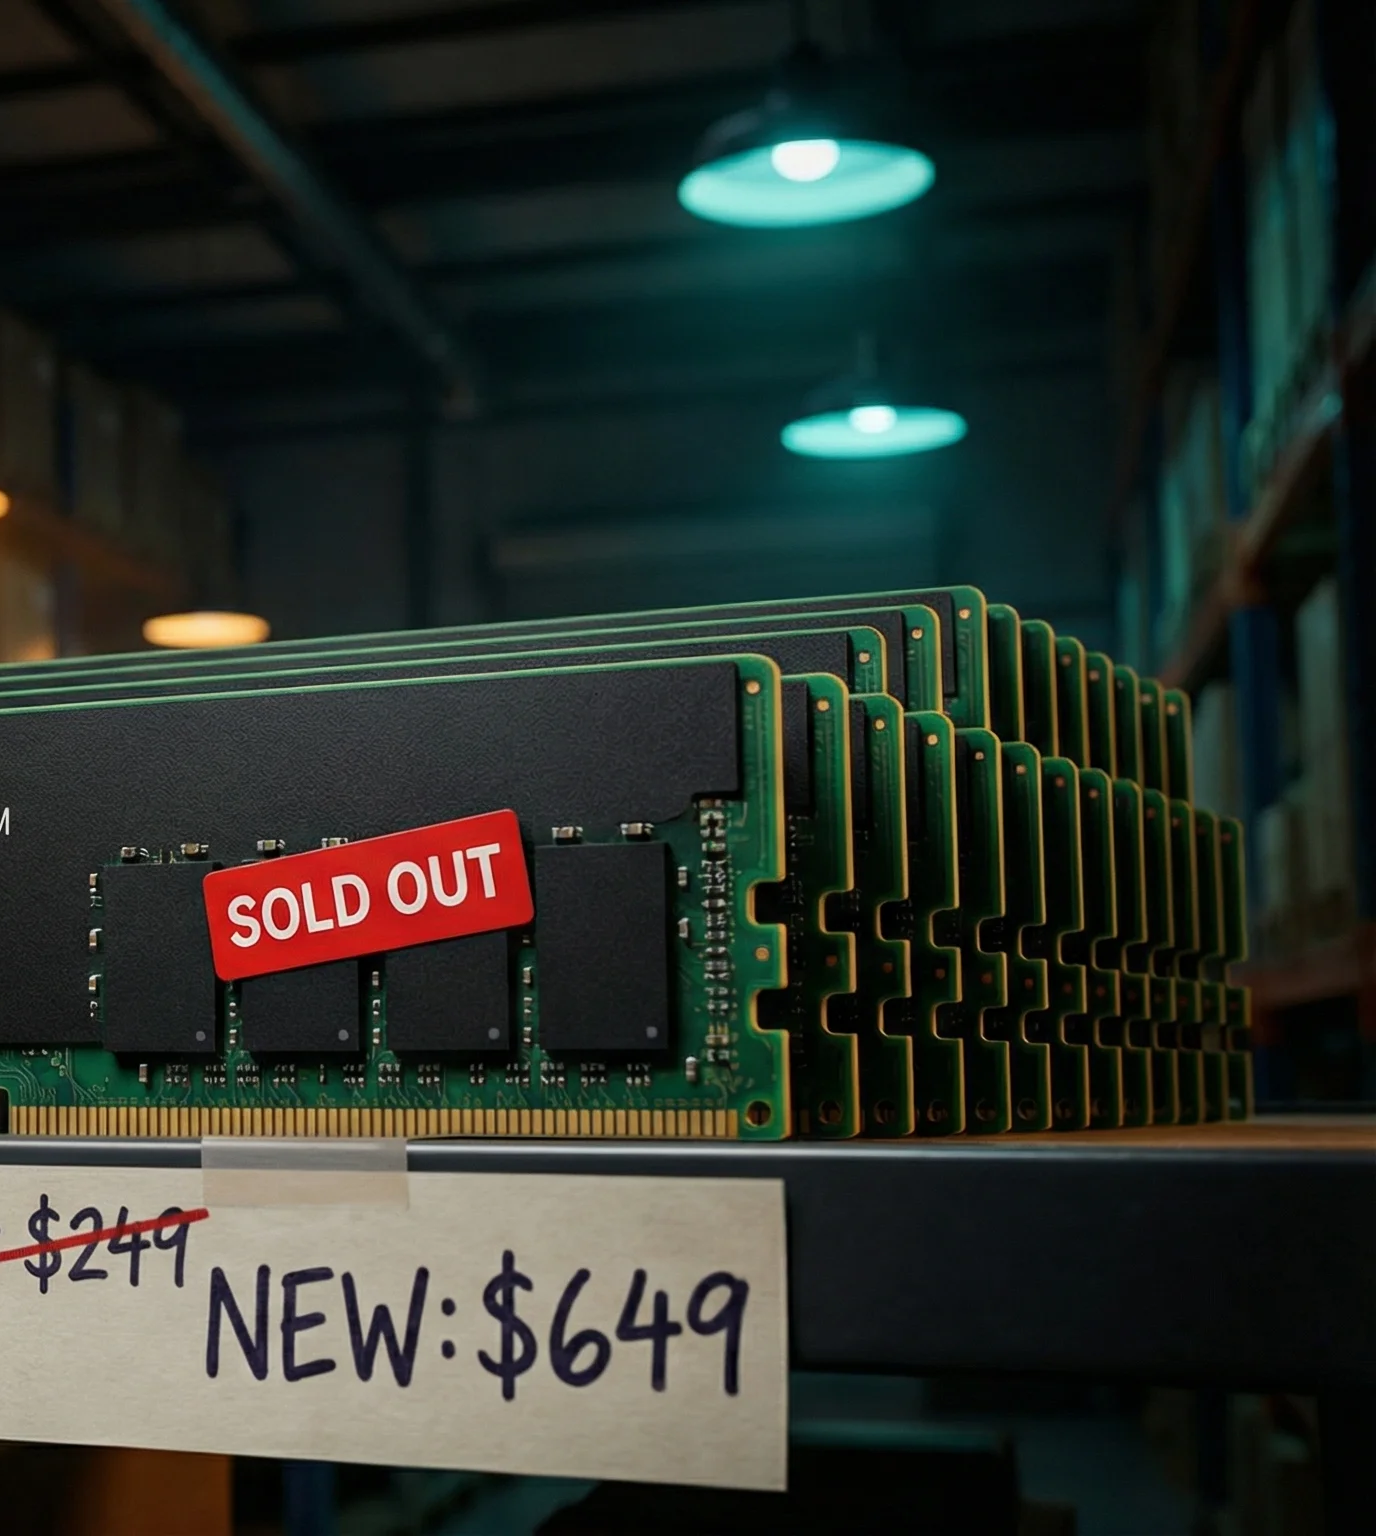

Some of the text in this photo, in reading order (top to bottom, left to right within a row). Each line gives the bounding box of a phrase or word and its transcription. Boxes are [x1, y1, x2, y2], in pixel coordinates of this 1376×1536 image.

[226, 842, 502, 949] SOLD OUT
[23, 1192, 192, 1296] $249
[204, 1249, 751, 1401] NEW: $649
